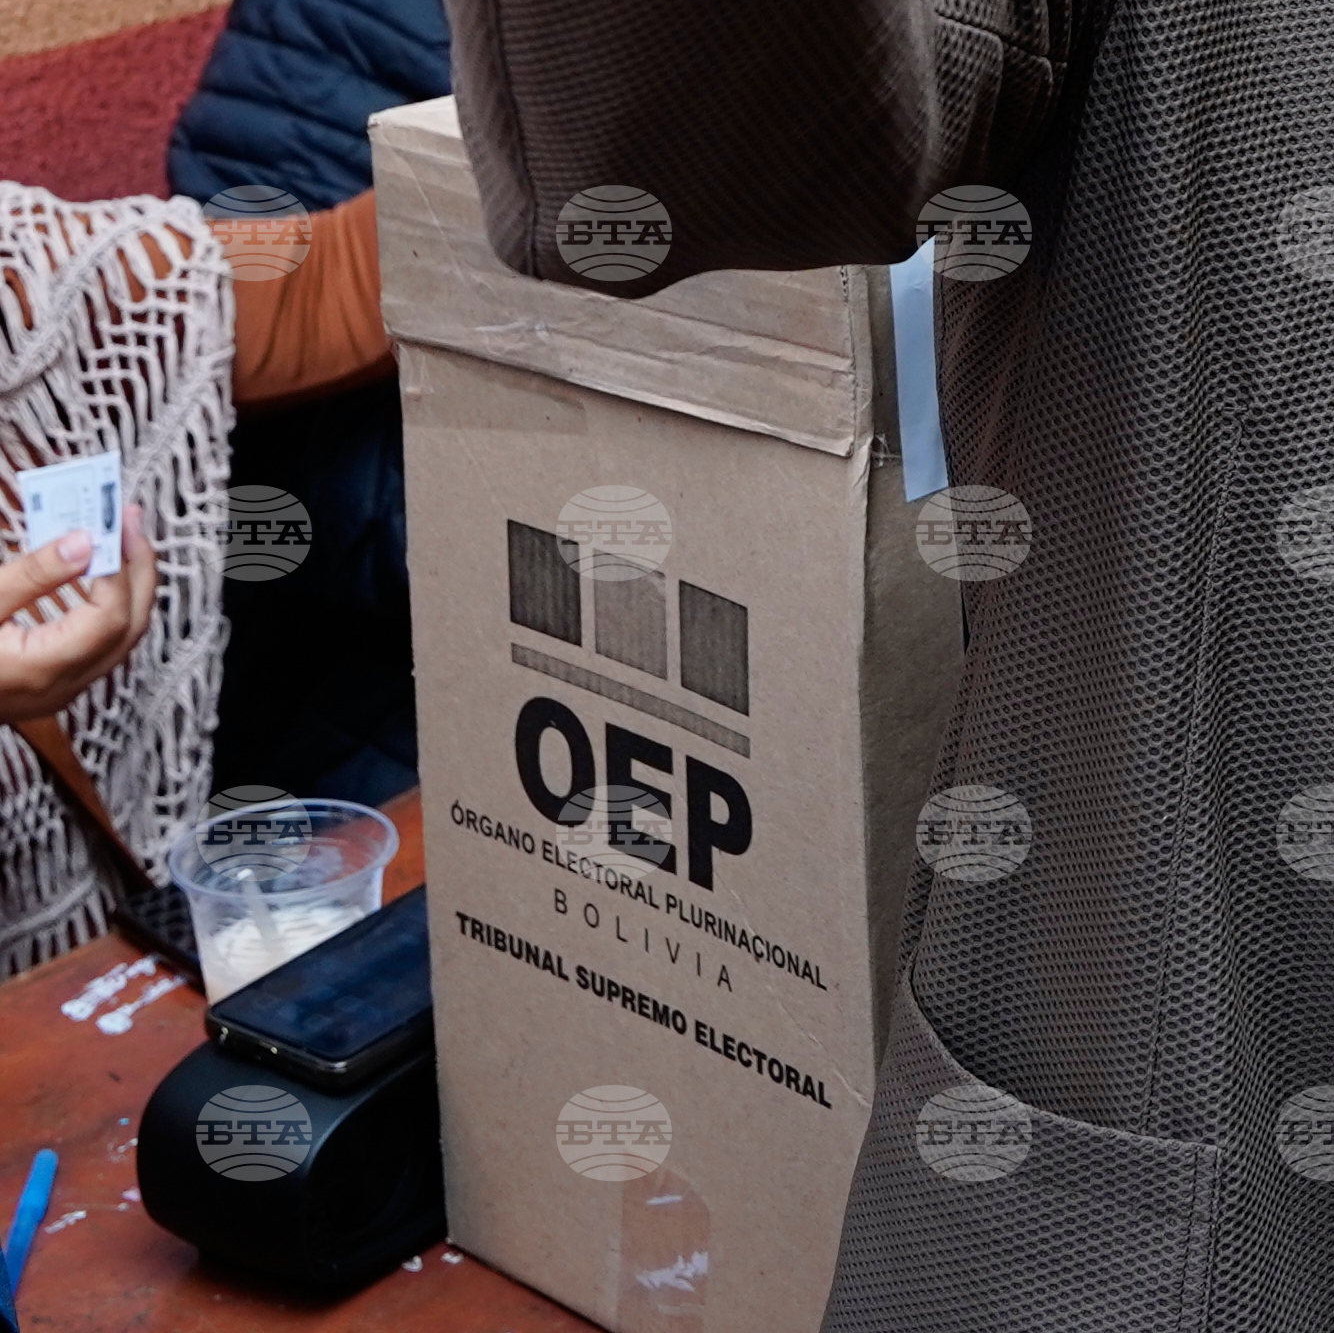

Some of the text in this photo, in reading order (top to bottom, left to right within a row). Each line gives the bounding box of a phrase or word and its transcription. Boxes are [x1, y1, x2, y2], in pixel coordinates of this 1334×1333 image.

[515, 696, 754, 892] OEP
[450, 799, 829, 992] ÓRGANO ELECTORAL PLURINACIONAL
[455, 910, 833, 1110] TRIBUNAL SUPREMO ELECTORAL
